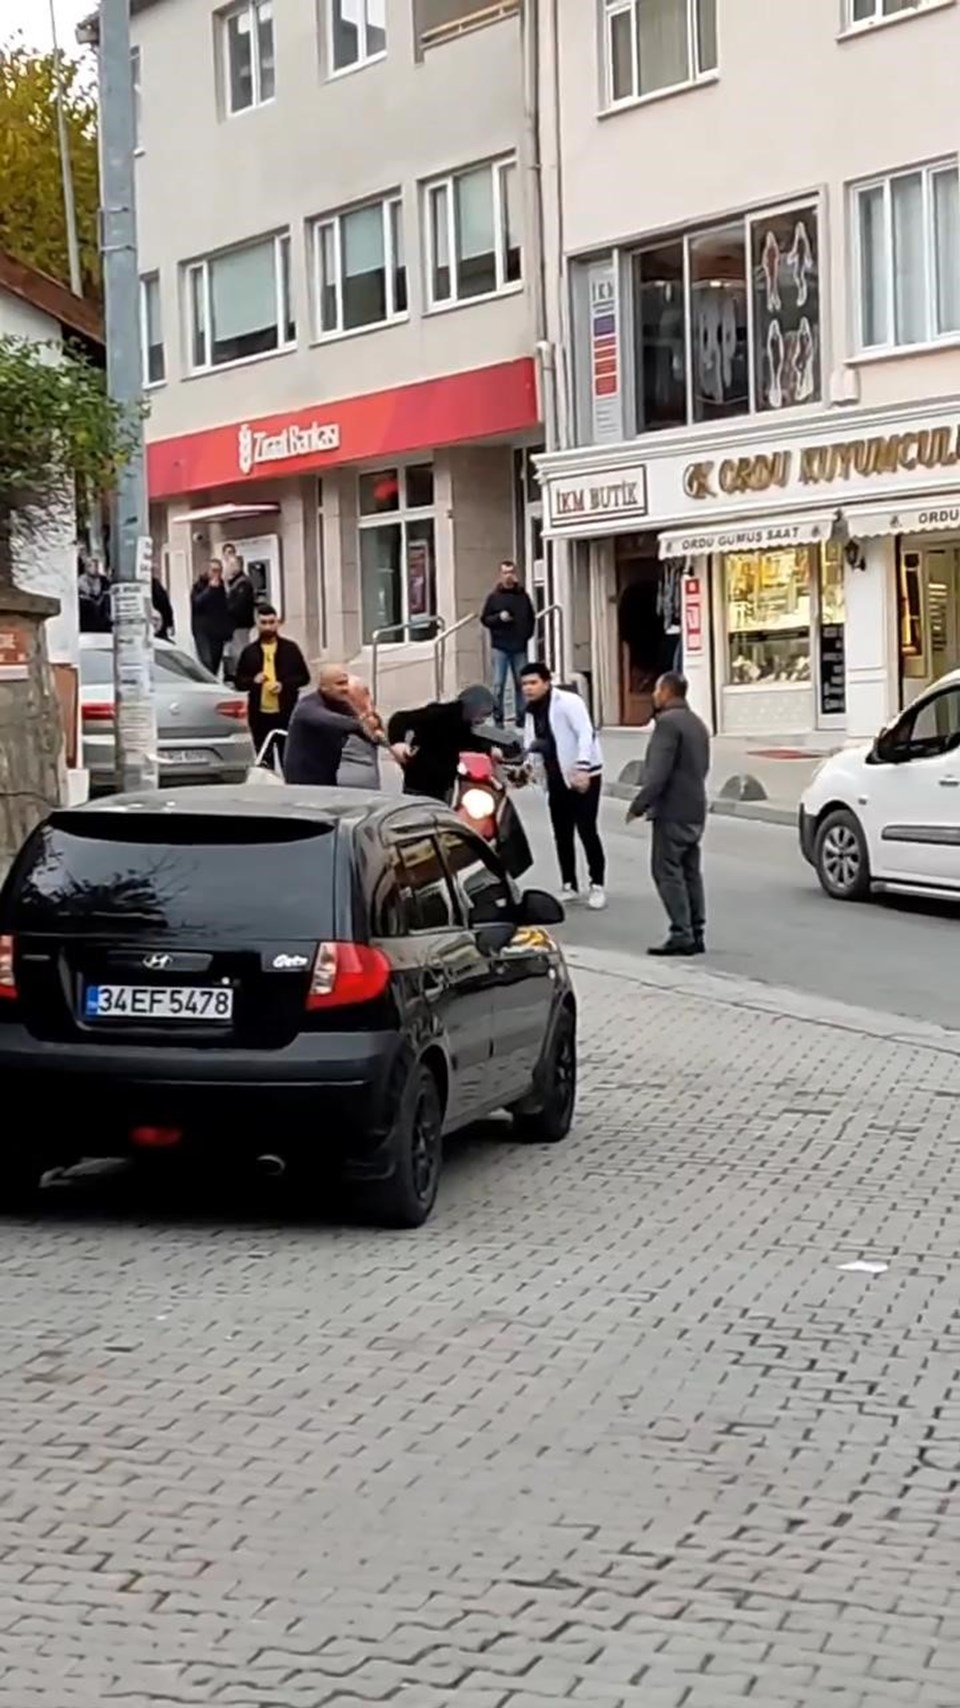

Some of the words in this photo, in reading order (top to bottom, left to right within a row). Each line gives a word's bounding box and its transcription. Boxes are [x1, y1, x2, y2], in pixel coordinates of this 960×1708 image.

[798, 424, 960, 485] KUYUMCUL
[918, 508, 959, 524] ORDU
[682, 538, 714, 550] ORDU
[766, 526, 799, 541] SAAT
